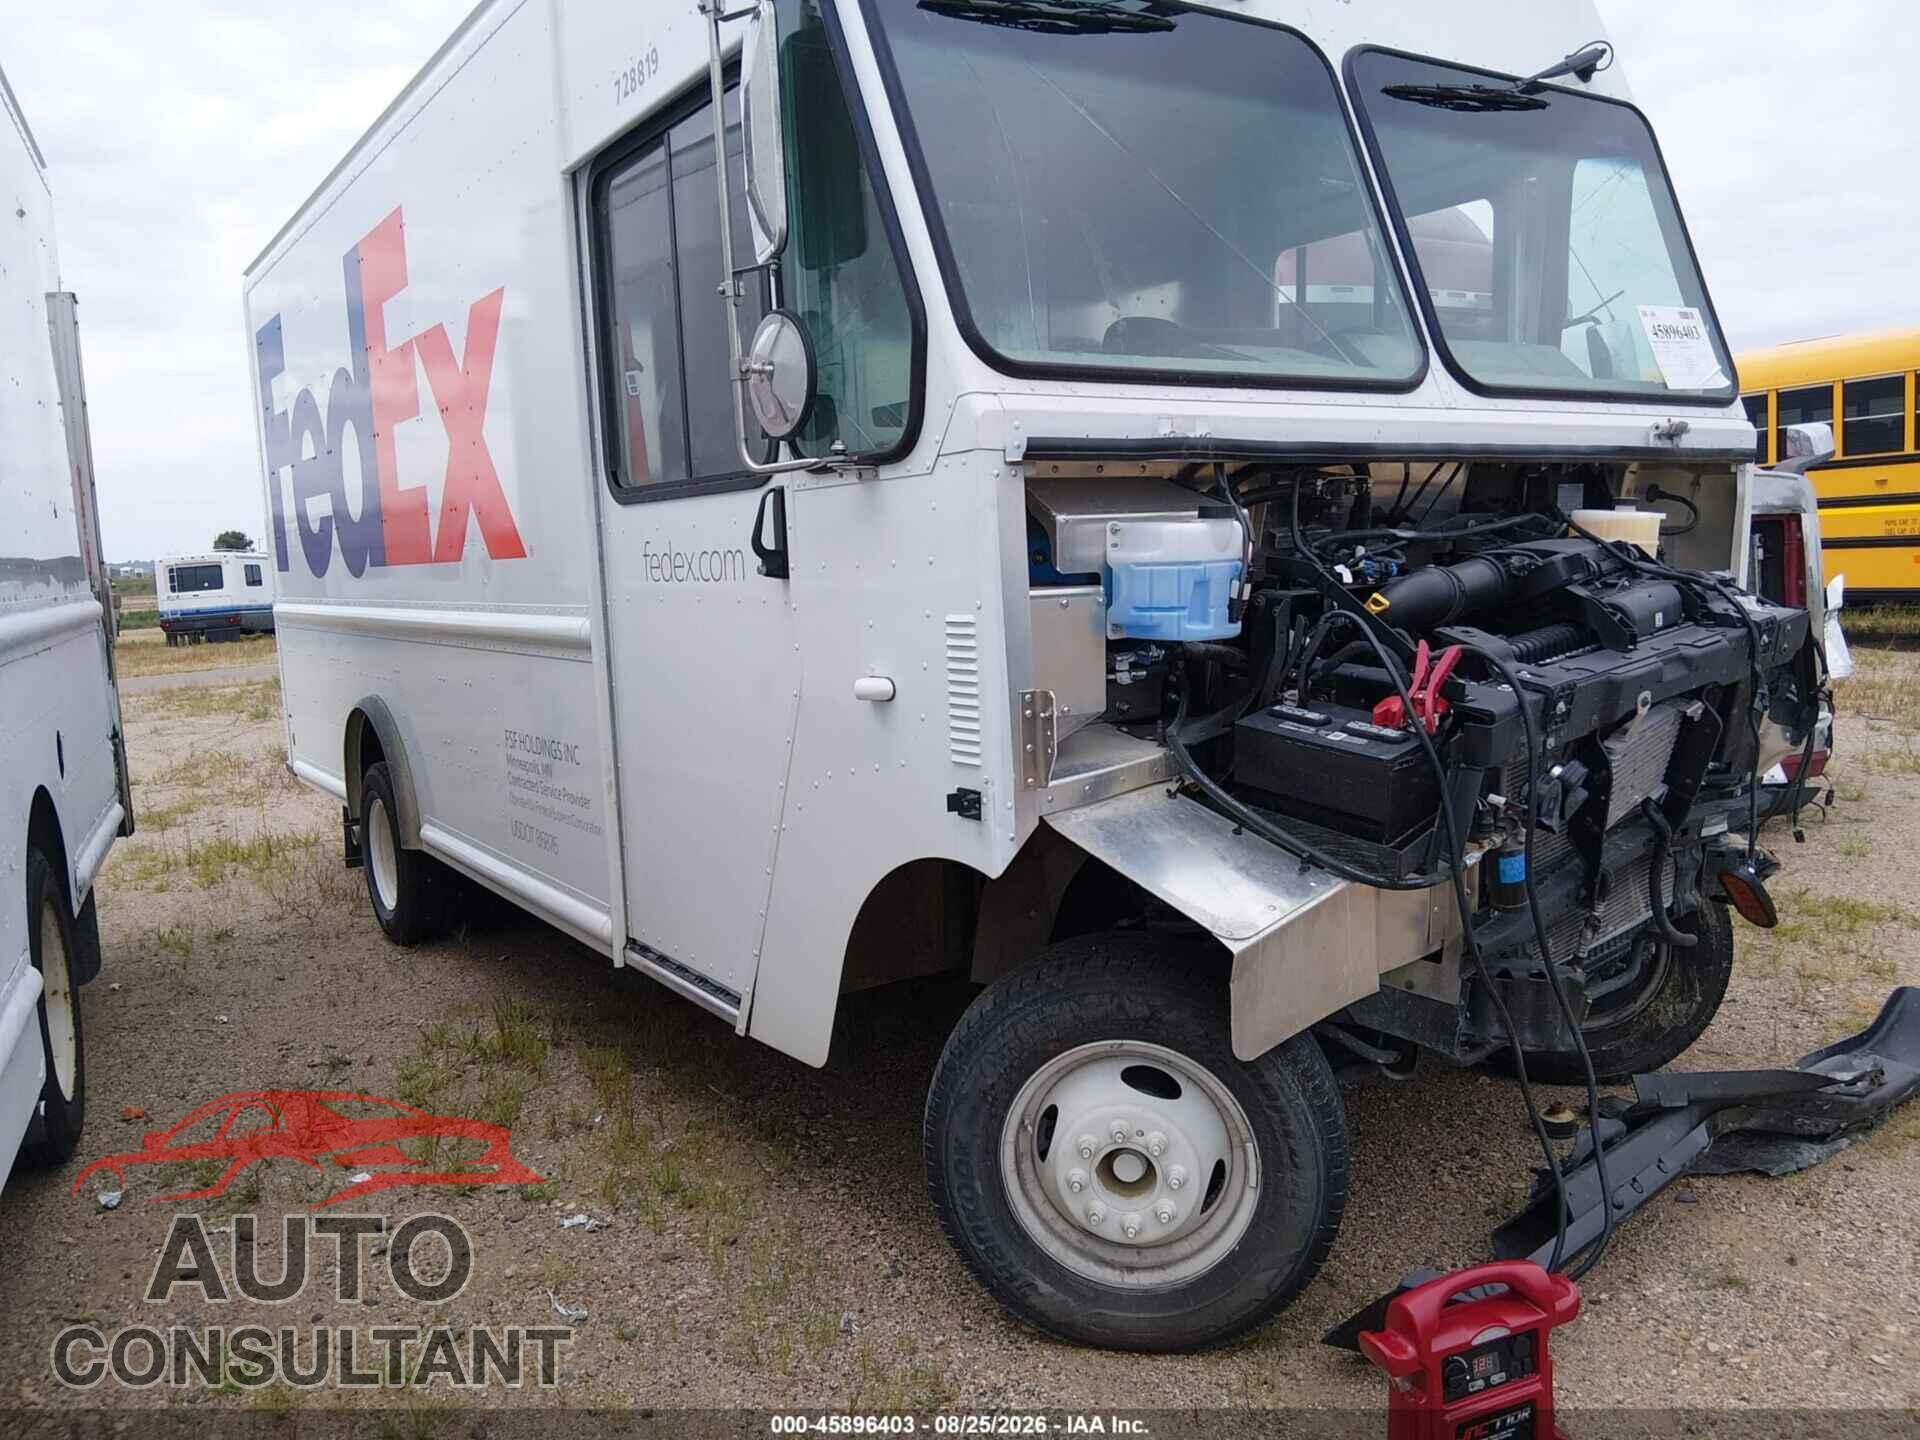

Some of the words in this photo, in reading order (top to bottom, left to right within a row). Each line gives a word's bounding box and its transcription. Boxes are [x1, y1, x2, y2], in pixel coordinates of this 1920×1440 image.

[614, 47, 658, 105] 728819
[1652, 323, 1701, 341] 45896403
[256, 204, 527, 579] FedEx
[643, 540, 745, 583] fedex.com
[518, 732, 563, 761] HOLDINGS
[563, 744, 581, 766] INC
